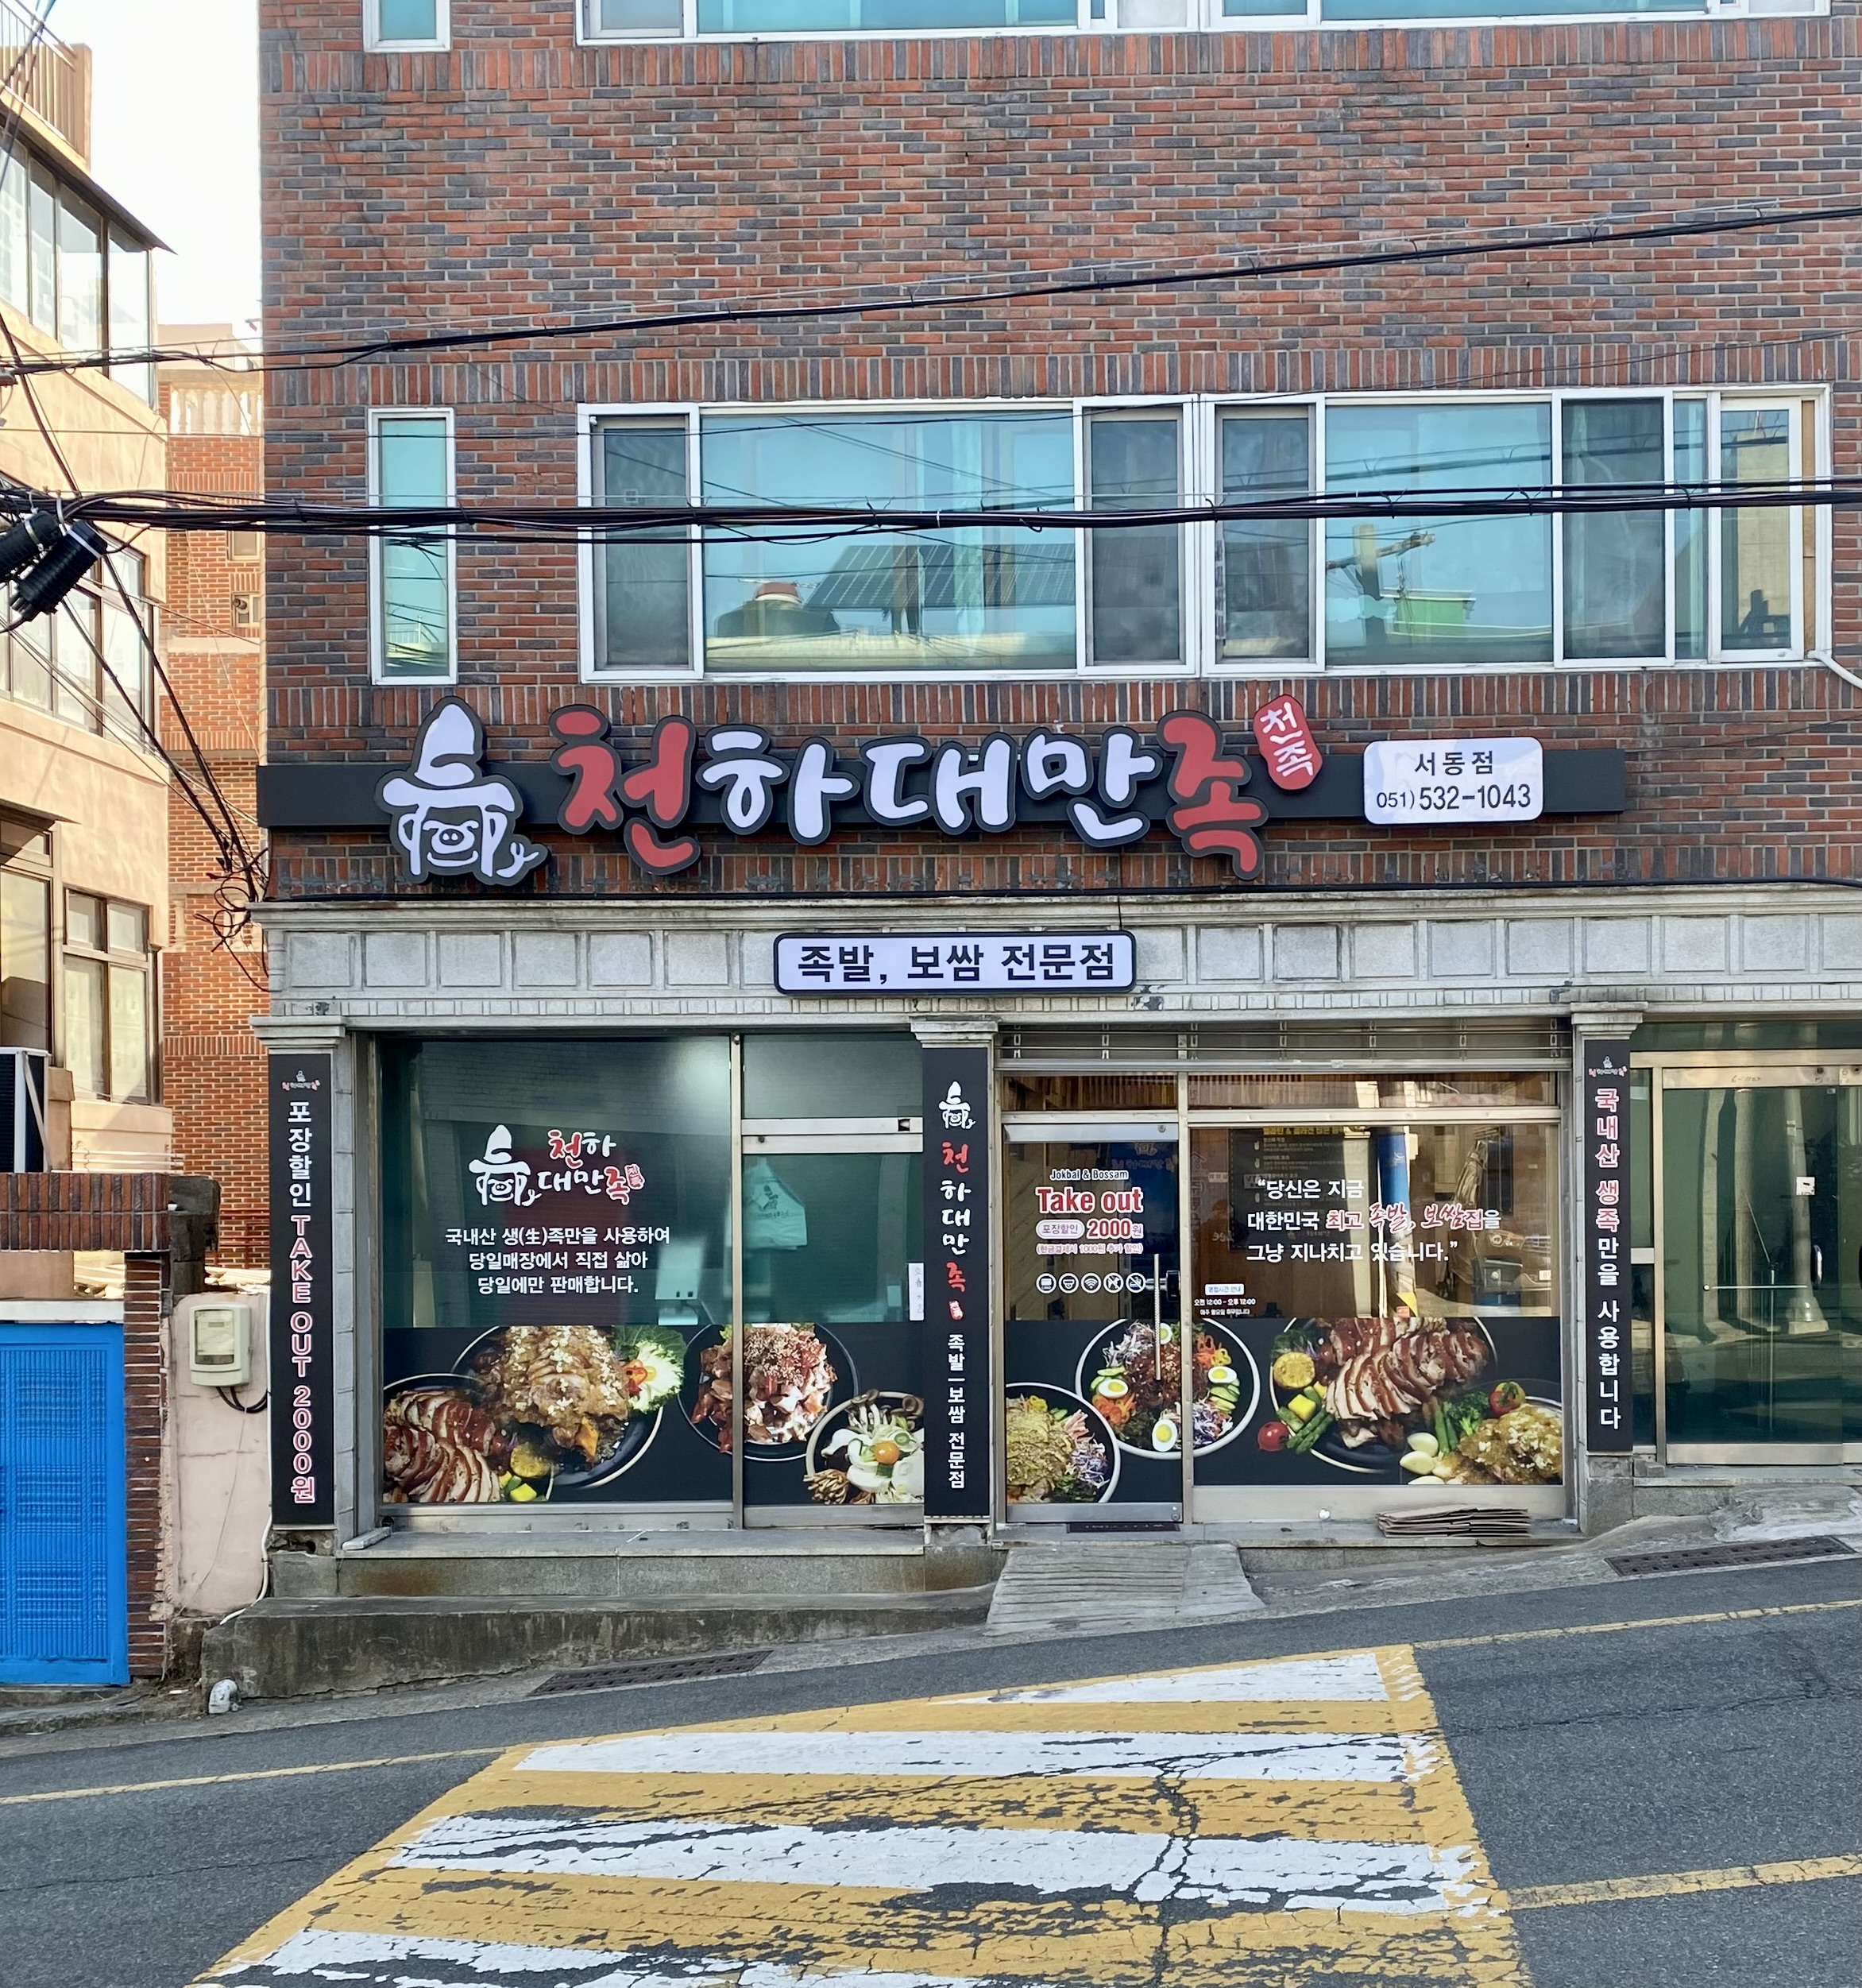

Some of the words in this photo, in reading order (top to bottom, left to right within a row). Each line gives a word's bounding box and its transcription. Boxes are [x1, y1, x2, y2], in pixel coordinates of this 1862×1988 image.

[1260, 702, 1313, 776] 천족
[1415, 749, 1494, 775] 서동점
[552, 707, 1265, 877] 천하대만족
[798, 945, 887, 984] 족발,
[907, 944, 983, 981] 보쌈
[1002, 942, 1114, 980] 전문점
[1595, 1088, 1620, 1168] 국내산
[288, 1102, 312, 1207] 포장할인
[547, 1128, 617, 1169] 천하
[537, 1166, 631, 1205] 대만족
[1050, 1169, 1080, 1181] Jokbal
[1082, 1170, 1091, 1181] &
[1091, 1169, 1129, 1180] Bossam
[1328, 1179, 1363, 1200] 지금
[1036, 1187, 1095, 1213] Take
[1101, 1187, 1144, 1213] out
[1248, 1210, 1319, 1231] 대한민국
[1325, 1208, 1364, 1231] 최고
[1369, 1203, 1416, 1234] 족발,
[1420, 1203, 1501, 1231] 보쌈집을
[446, 1228, 496, 1246] 국내산
[502, 1227, 597, 1246] 생(生)족만을
[603, 1227, 670, 1245] 사용하여
[1247, 1243, 1283, 1263] 그냥
[1290, 1243, 1363, 1262] 지나치고
[1596, 1180, 1620, 1286] 생족만을
[289, 1215, 313, 1303] TAKE
[469, 1251, 568, 1271] 당일매장에서
[575, 1251, 608, 1270] 직접
[614, 1251, 647, 1270] 삶아
[477, 1277, 544, 1294] 당일에만
[550, 1275, 639, 1294] 판매합니다.
[290, 1311, 313, 1377] OUT
[948, 1334, 965, 1371] 족발
[1597, 1300, 1621, 1429] 사용합니다
[948, 1387, 965, 1424] 보쌈
[291, 1385, 315, 1503] 2000원
[948, 1432, 965, 1490] 전문점
